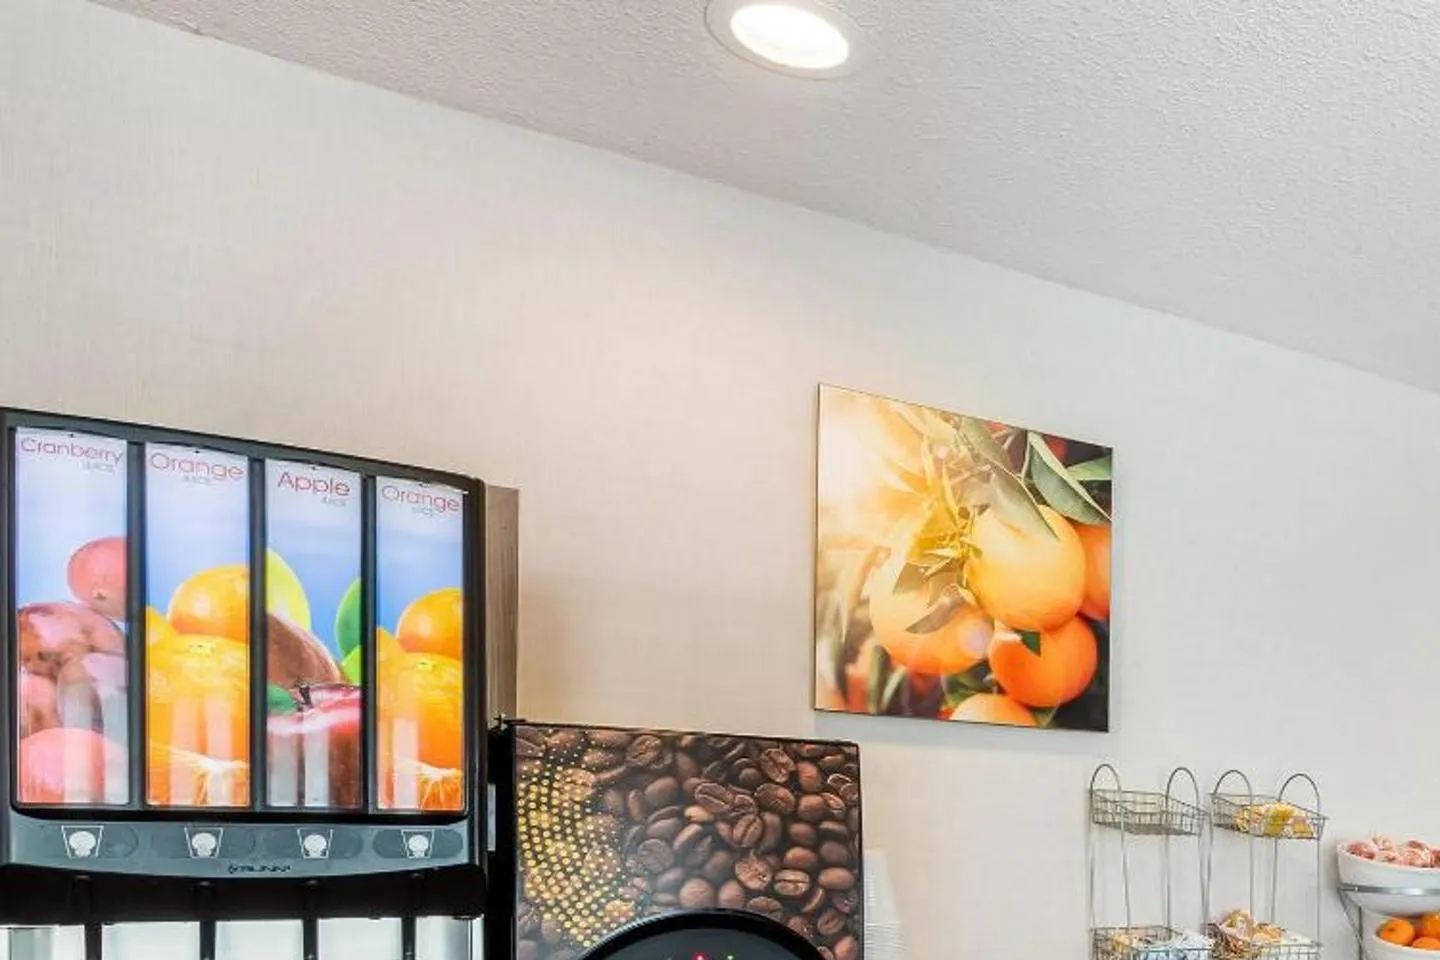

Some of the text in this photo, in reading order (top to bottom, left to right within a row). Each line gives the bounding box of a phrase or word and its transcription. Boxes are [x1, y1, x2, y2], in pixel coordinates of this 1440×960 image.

[21, 437, 124, 464] Cranberry
[151, 453, 244, 480] Orange
[278, 471, 351, 496] Apple
[381, 485, 460, 513] Orange
